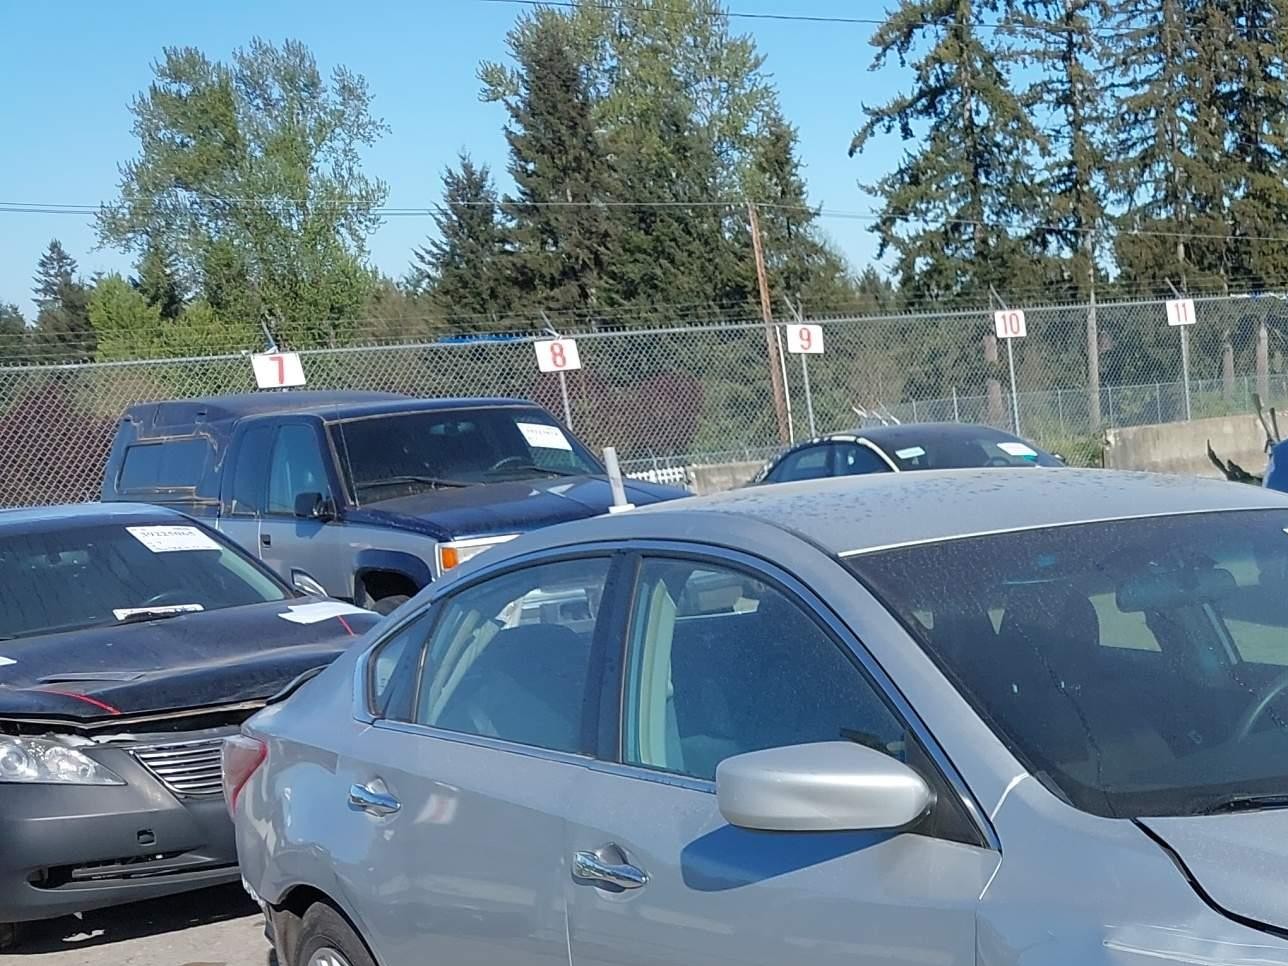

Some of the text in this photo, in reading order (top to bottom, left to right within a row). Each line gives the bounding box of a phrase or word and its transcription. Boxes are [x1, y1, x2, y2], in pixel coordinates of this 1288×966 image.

[1001, 312, 1020, 336] 10
[1173, 302, 1189, 322] 11
[799, 327, 812, 350] 9
[550, 342, 567, 368] 8
[269, 356, 285, 385] 7
